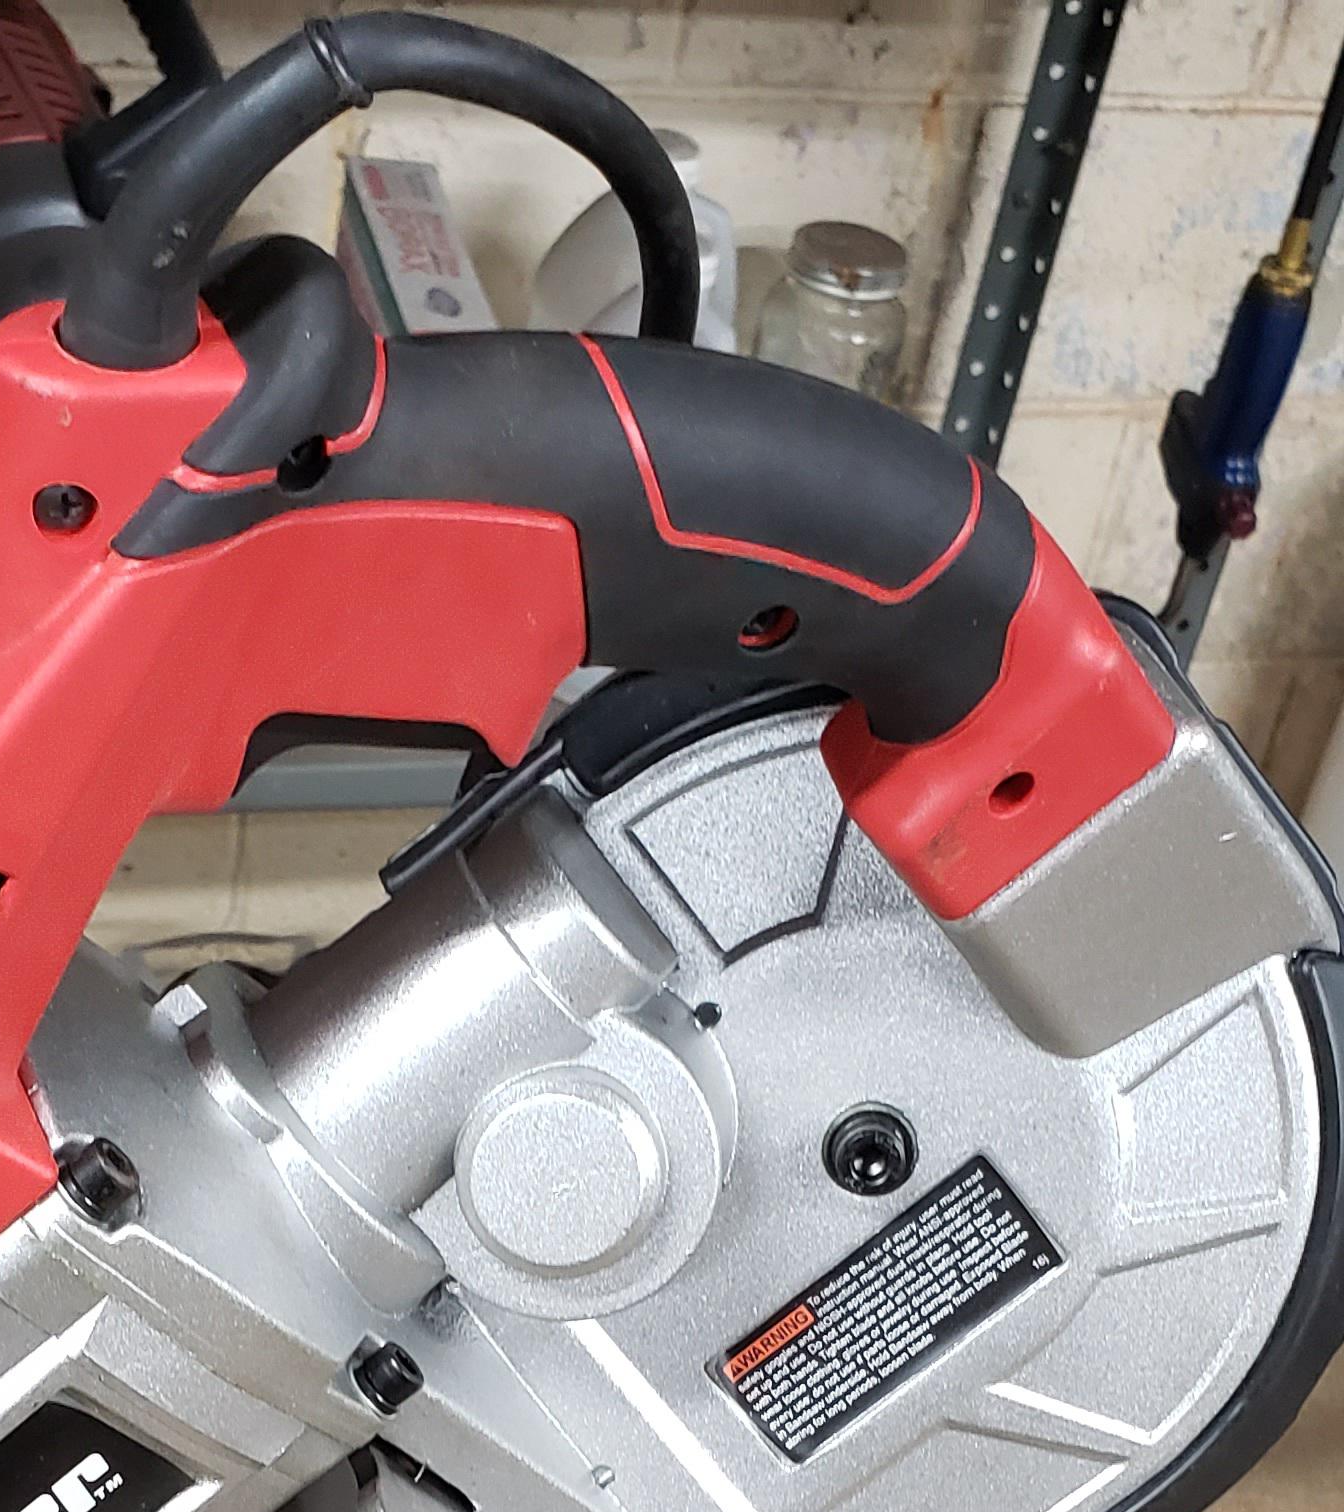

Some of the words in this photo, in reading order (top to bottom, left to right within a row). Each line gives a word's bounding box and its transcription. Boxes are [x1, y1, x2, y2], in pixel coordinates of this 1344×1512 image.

[734, 1367, 768, 1396] safety
[760, 1341, 801, 1376] goggles
[794, 1328, 816, 1348] and
[883, 1258, 908, 1280] dust
[902, 1207, 975, 1267] mask/respirator
[968, 1185, 1004, 1216] during
[743, 1385, 762, 1403] set
[758, 1378, 776, 1394] up
[769, 1363, 792, 1383] and
[805, 1337, 825, 1355] Do
[819, 1326, 840, 1345] not
[835, 1315, 856, 1333] use
[850, 1289, 888, 1321] without
[882, 1266, 919, 1298] guards
[949, 1221, 976, 1245] Hold
[970, 1208, 994, 1229] tool
[750, 1392, 774, 1413] with
[769, 1377, 794, 1399] both
[817, 1331, 856, 1364] Tighten
[849, 1312, 879, 1338] blade
[873, 1299, 896, 1319] and
[902, 1269, 935, 1297] knobs
[929, 1247, 963, 1276] before
[978, 1221, 998, 1239] Do
[993, 1209, 1014, 1228] not
[759, 1401, 785, 1423] wear
[780, 1381, 809, 1406] loose
[838, 1332, 874, 1363] gloves
[908, 1280, 943, 1310] during
[955, 1239, 995, 1274] Inspect
[988, 1217, 1023, 1247] before
[812, 1278, 862, 1319] instruction
[891, 1233, 921, 1259] Wear
[915, 1183, 987, 1242] ANSI-approved
[816, 1269, 852, 1300] reduce
[846, 1258, 867, 1277] the
[862, 1245, 884, 1265] risk
[916, 1202, 941, 1224] user
[936, 1183, 964, 1208] must
[958, 1167, 985, 1191] read
[736, 1308, 810, 1369] WARNING
[767, 1408, 797, 1434] every
[808, 1382, 827, 1399] do
[821, 1371, 842, 1390] not
[838, 1360, 859, 1378] use
[860, 1336, 889, 1362] parts
[882, 1317, 912, 1343] loose
[960, 1247, 1005, 1286] Exposed
[998, 1227, 1031, 1255] Blade
[782, 1421, 818, 1453] storing
[810, 1412, 829, 1429] for
[823, 1397, 850, 1421] long
[876, 1349, 911, 1379] loosen
[783, 1397, 828, 1434] Bandsaw
[865, 1348, 892, 1372] Hold
[886, 1318, 933, 1356] Bandsaw
[927, 1301, 958, 1328] away
[950, 1284, 977, 1308] from
[995, 1245, 1028, 1273] When
